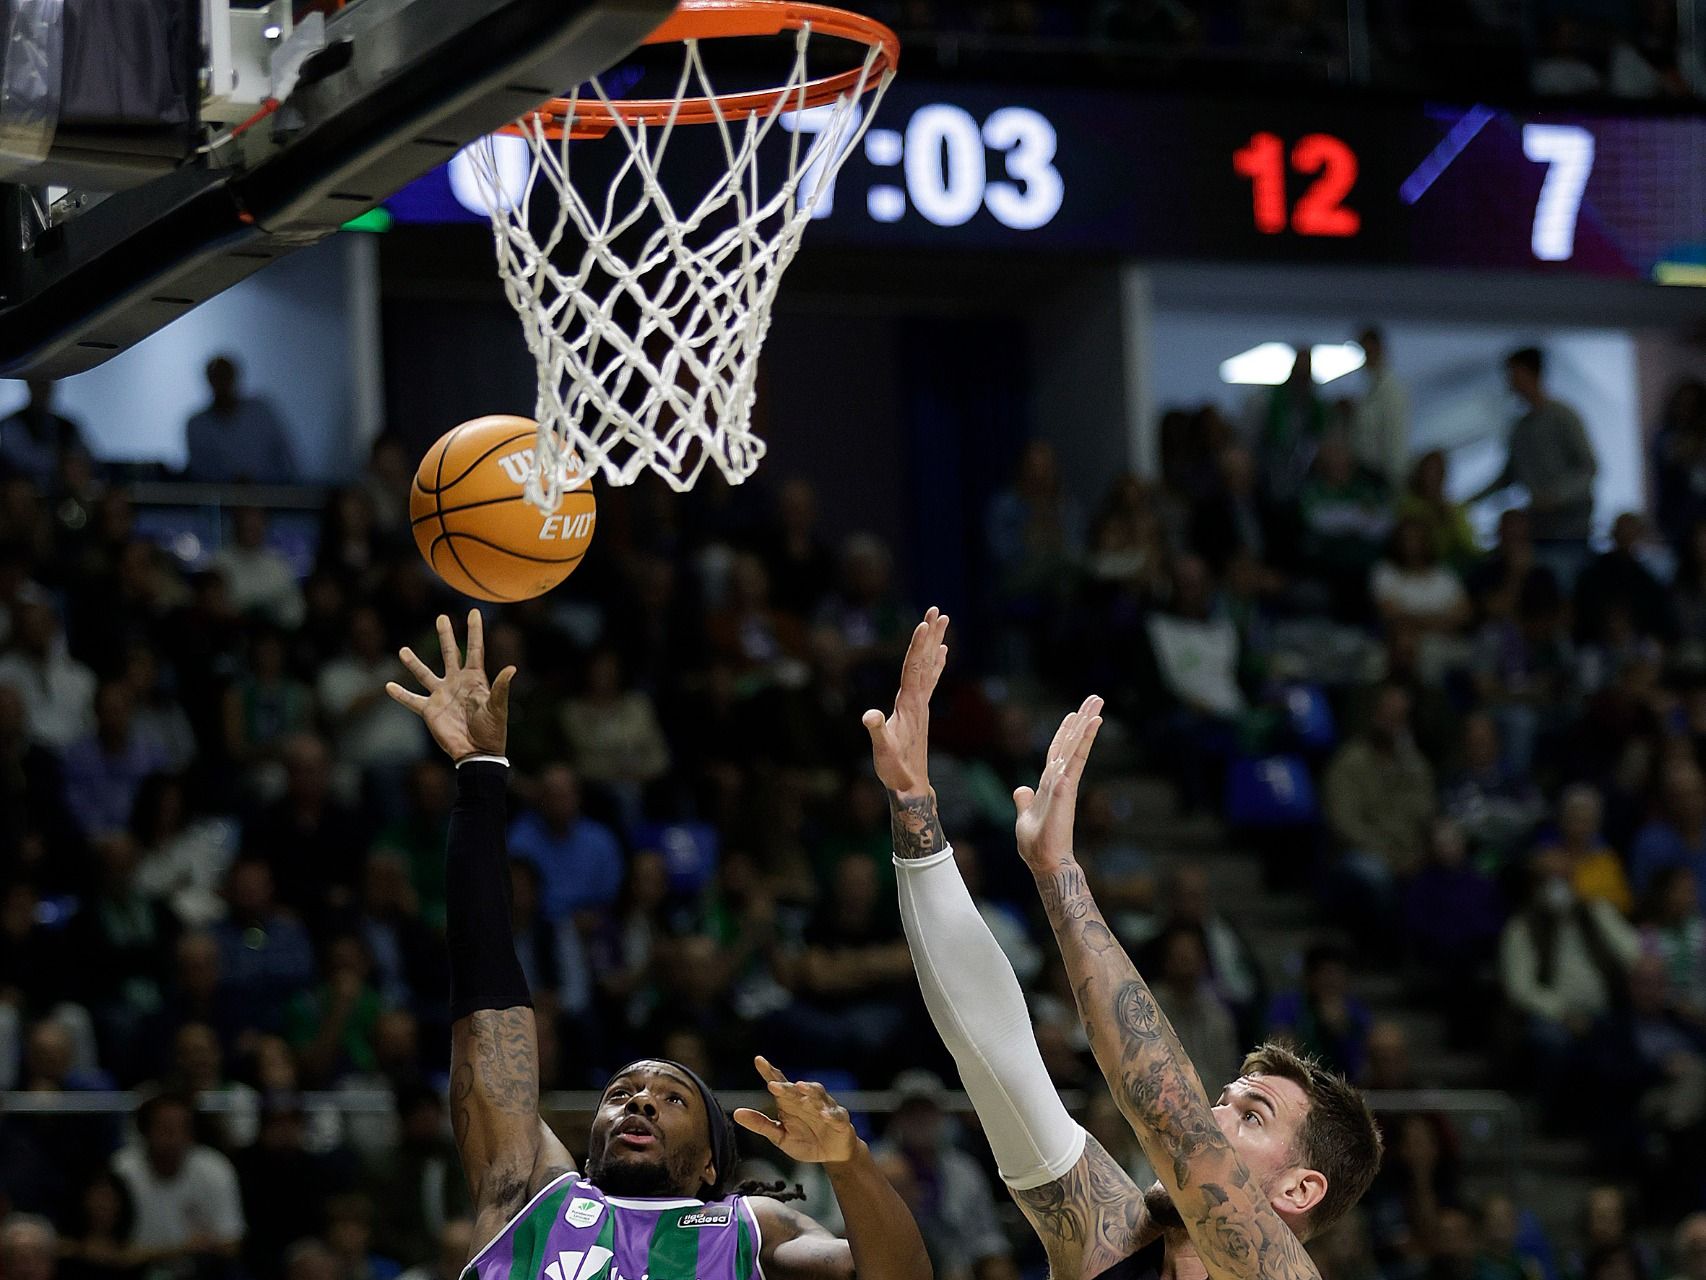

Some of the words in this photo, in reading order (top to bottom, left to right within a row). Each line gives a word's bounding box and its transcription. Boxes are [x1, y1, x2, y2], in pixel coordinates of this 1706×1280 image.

[779, 103, 1065, 231] 7:03
[1233, 132, 1362, 237] 12
[1522, 124, 1596, 261] 7
